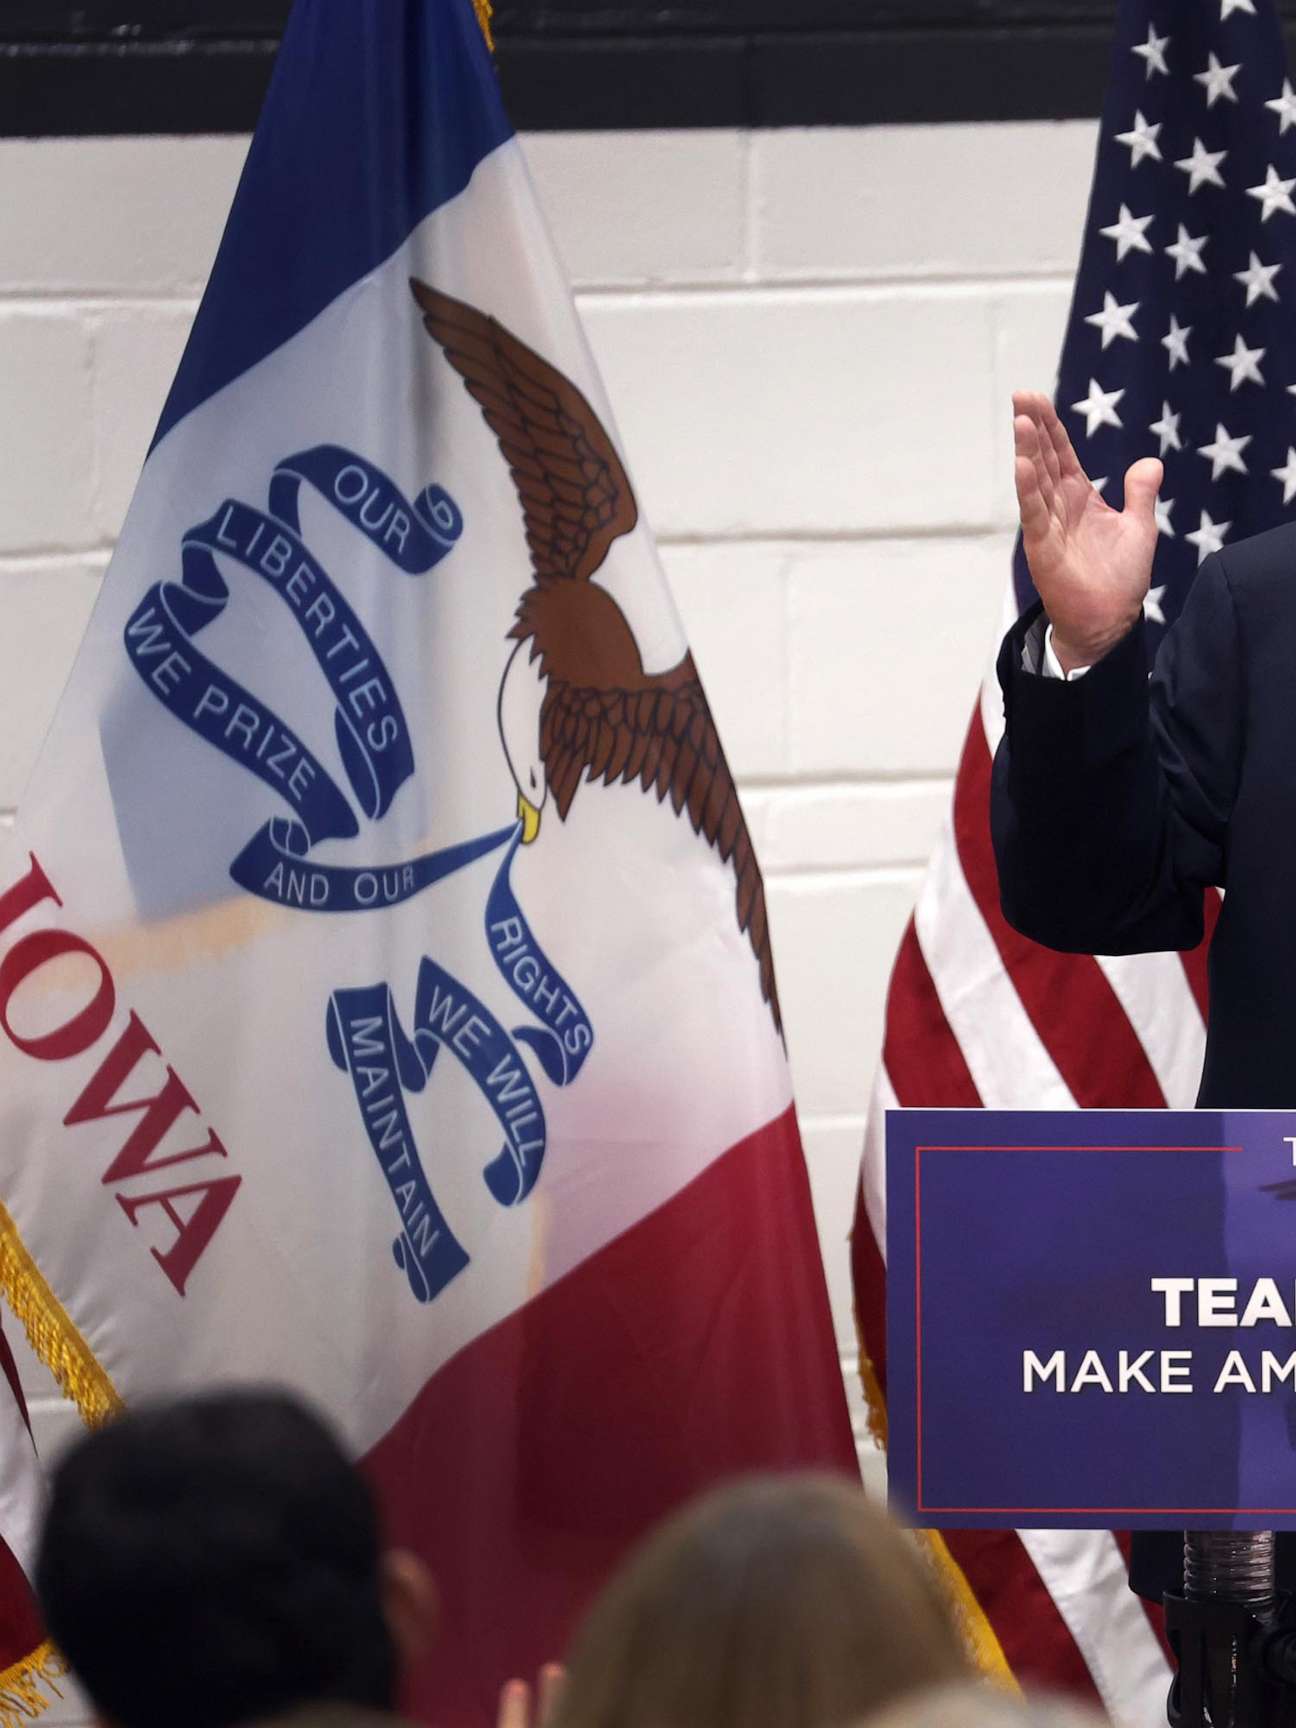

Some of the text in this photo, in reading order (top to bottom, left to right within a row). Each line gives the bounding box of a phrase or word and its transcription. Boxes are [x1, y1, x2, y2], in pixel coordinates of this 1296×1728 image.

[333, 464, 411, 554] OUR
[127, 606, 317, 800] WE PRIZE
[215, 505, 398, 752] LIBERTIES
[263, 862, 416, 905] AND OUR
[0, 850, 244, 1299] IOWA
[428, 985, 545, 1168] WE WILL
[489, 915, 593, 1056] RIGHTS
[349, 1015, 441, 1258] MAINTAIN
[1023, 1350, 1193, 1393] MAKE
